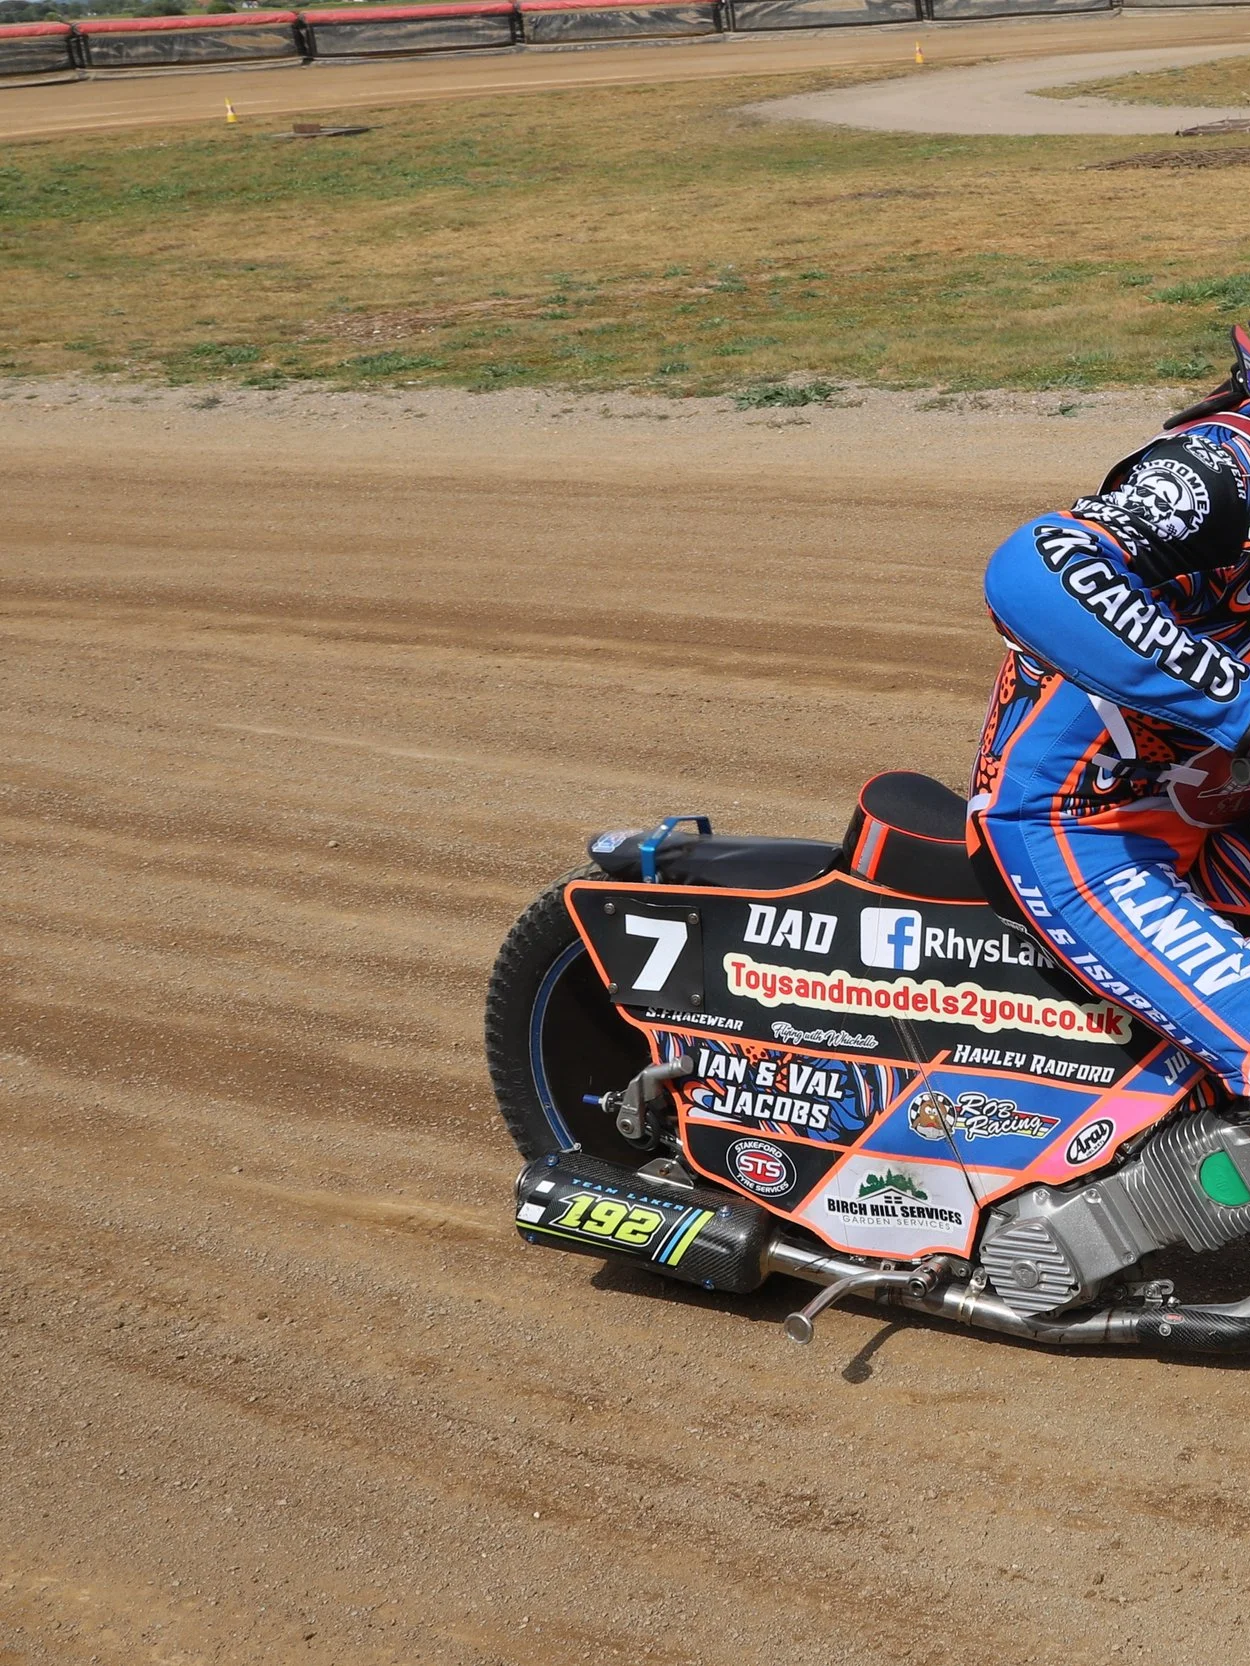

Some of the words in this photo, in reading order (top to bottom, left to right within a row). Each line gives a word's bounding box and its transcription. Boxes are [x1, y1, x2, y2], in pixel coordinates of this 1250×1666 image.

[1068, 560, 1246, 697] CARPETS
[743, 903, 838, 954] DAD
[625, 914, 688, 992] 7
[1011, 873, 1053, 918] JO
[1070, 951, 1219, 1063] ISABELLE
[731, 961, 1124, 1036] Toysandmodels2you.co.uk
[771, 1021, 804, 1045] Flying
[804, 1029, 826, 1043] with
[825, 1029, 879, 1049] Whichello
[698, 1048, 750, 1084] IAN
[755, 1061, 777, 1087] &
[788, 1063, 843, 1099] VAL
[954, 1044, 1026, 1069] HAYLEY
[1029, 1055, 1116, 1084] RADFORD
[713, 1085, 830, 1129] JACOBS
[959, 1094, 1017, 1118] ROB
[966, 1115, 1043, 1140] Racing
[1071, 1122, 1108, 1160] Arai
[734, 1141, 783, 1158] STAKEFORD
[739, 1155, 781, 1178] STS
[572, 1178, 617, 1196] TEAM
[627, 1193, 685, 1211] LAKER
[737, 1173, 755, 1189] TYRE
[755, 1181, 790, 1193] SERVICES
[553, 1193, 664, 1245] 192
[827, 1198, 867, 1216] BIRCH
[870, 1204, 898, 1217] HILL
[899, 1205, 963, 1226] SERVICES
[842, 1215, 891, 1226] GARDEN
[896, 1218, 951, 1231] SERVICES
